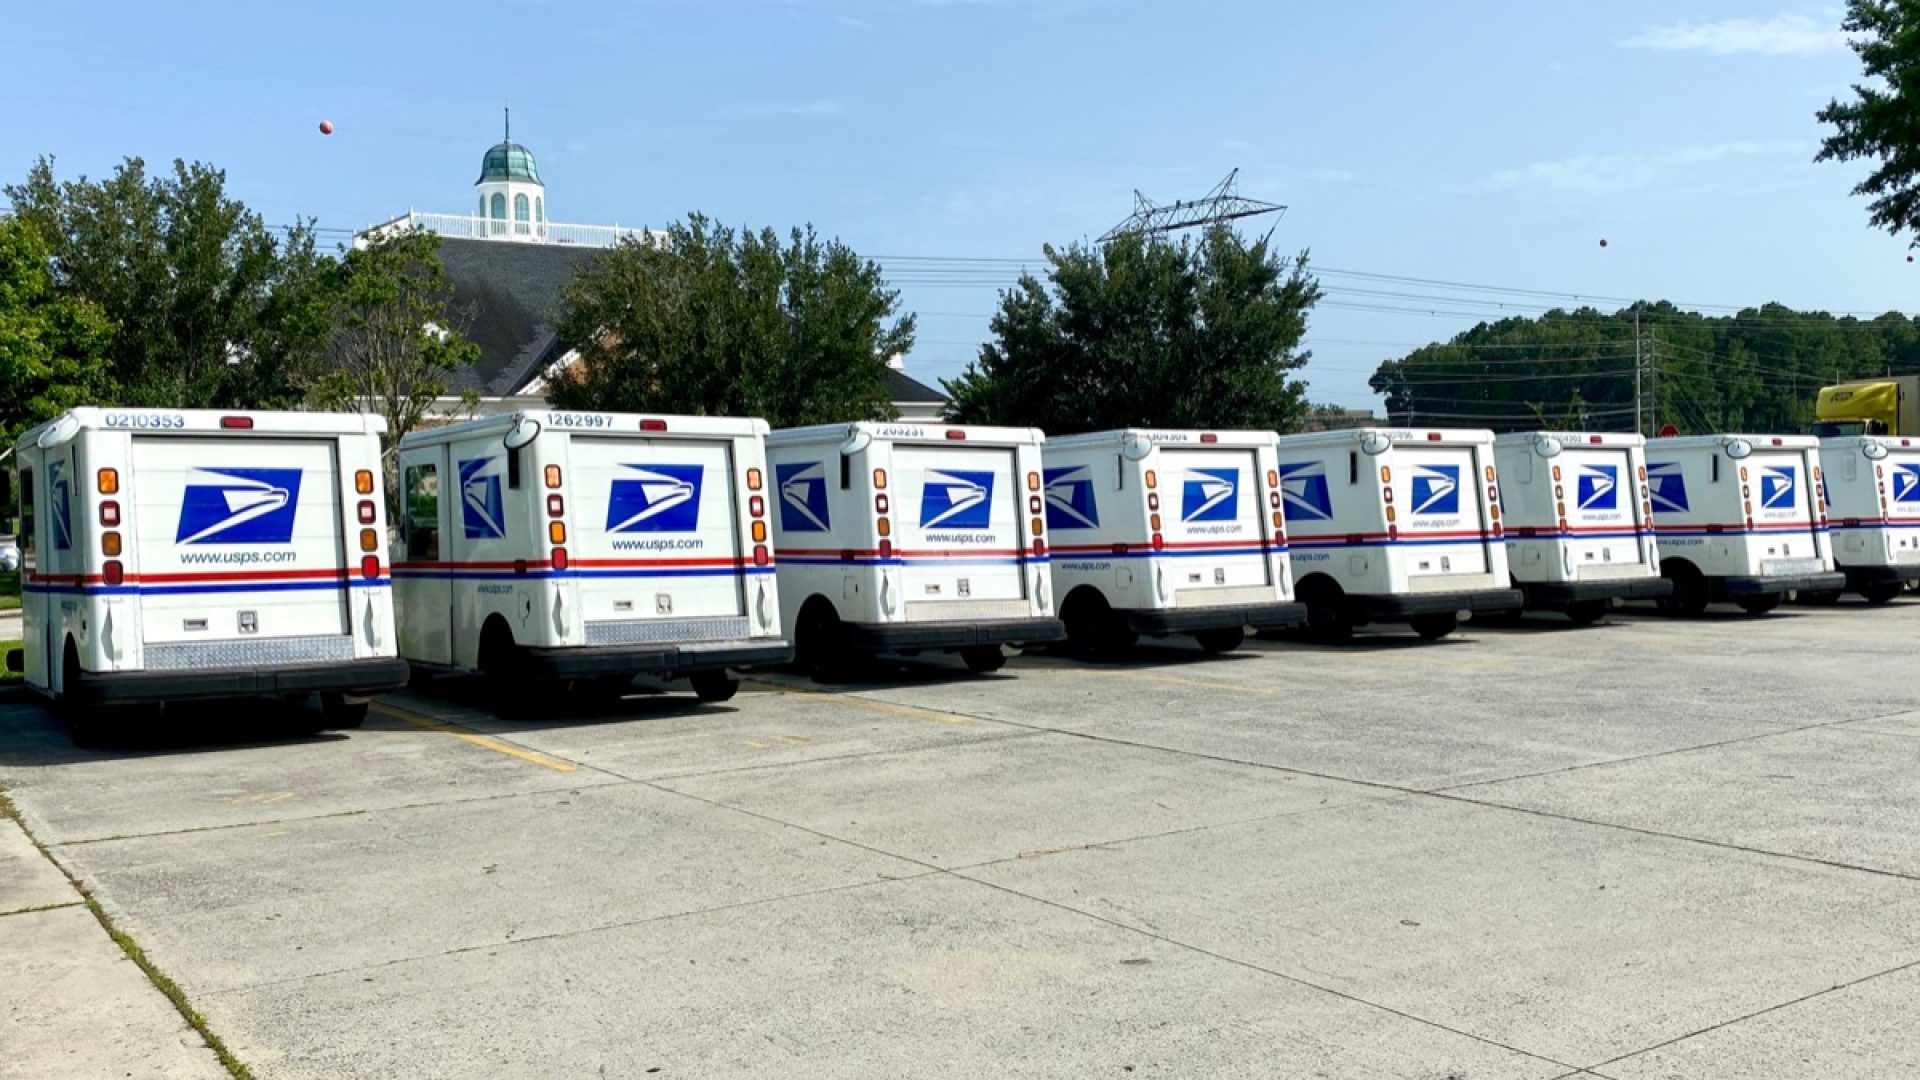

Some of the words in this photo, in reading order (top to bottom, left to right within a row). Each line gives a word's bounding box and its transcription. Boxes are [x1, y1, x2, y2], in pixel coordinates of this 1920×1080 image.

[105, 413, 185, 428] 0210353
[547, 413, 613, 428] 1262997
[612, 539, 704, 552] www.usps.com
[926, 533, 996, 545] www.usps.com
[180, 551, 297, 566] www.usps.com
